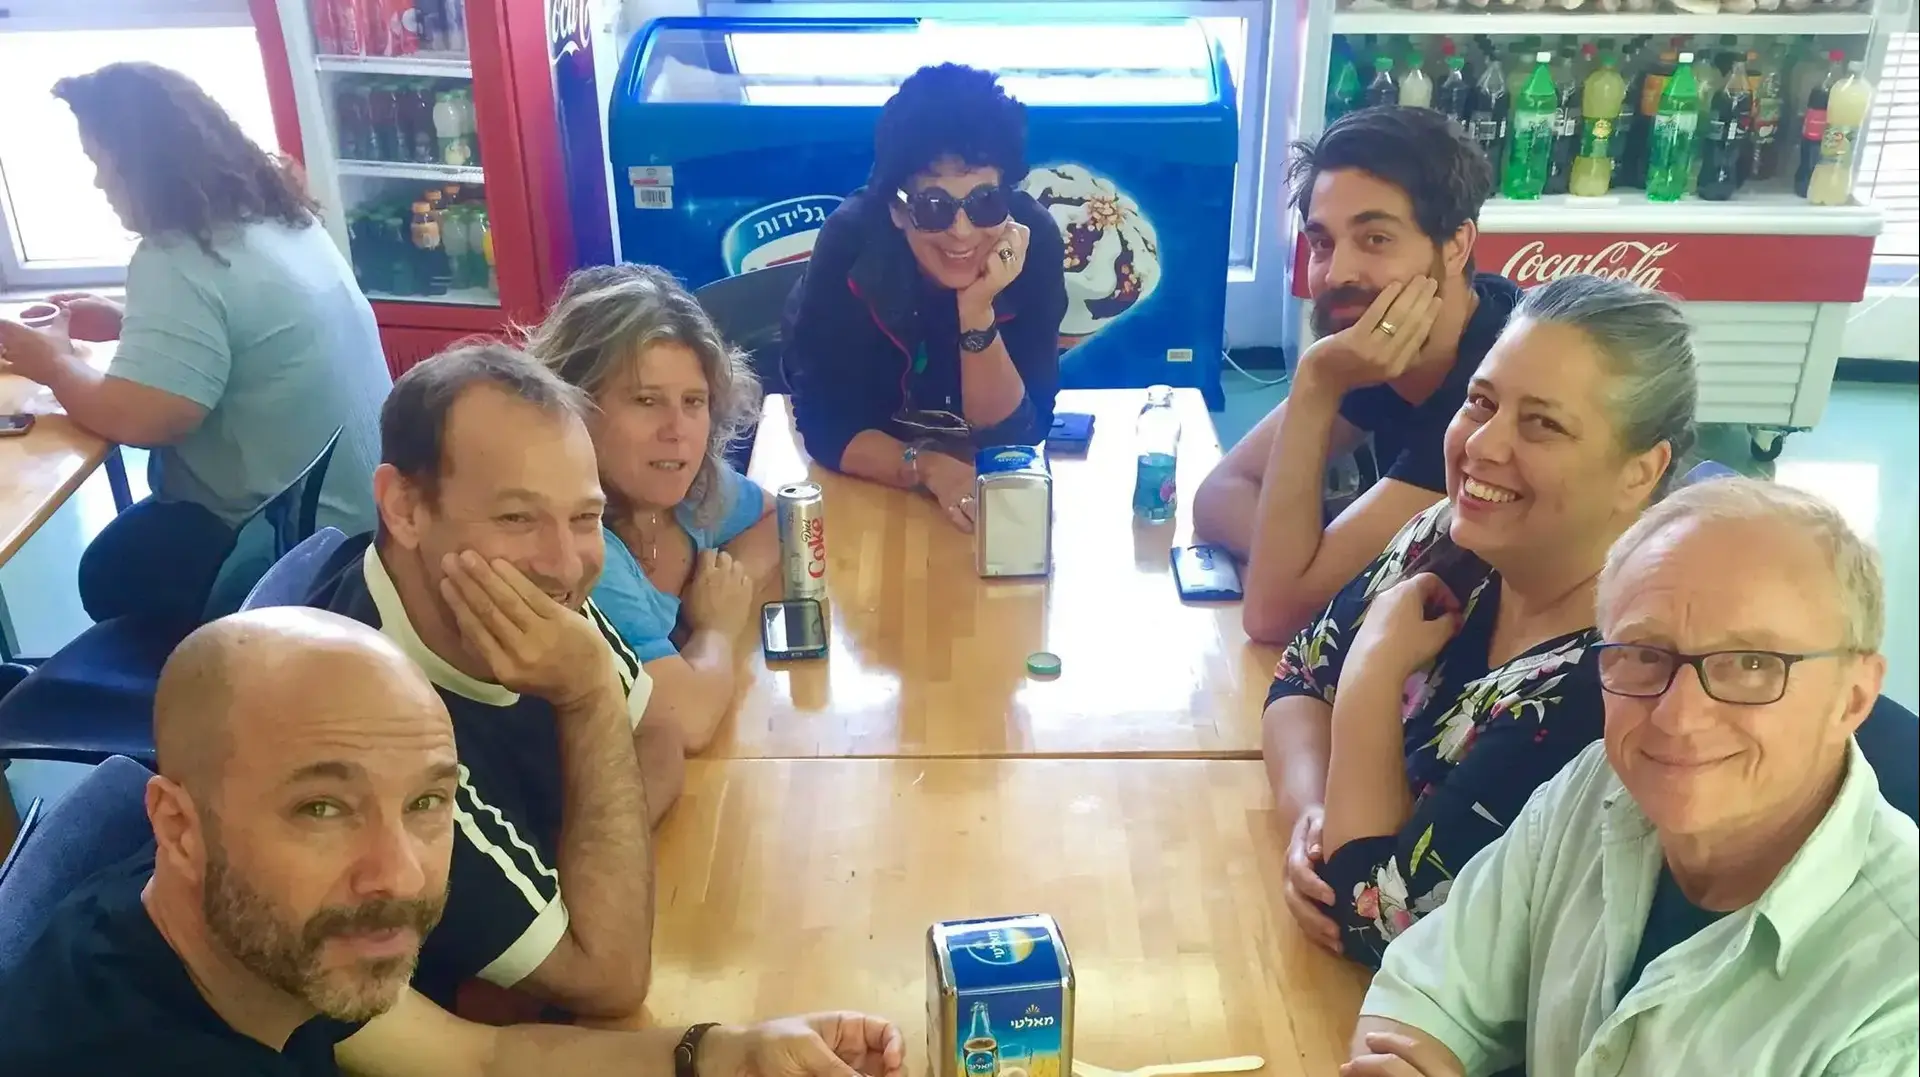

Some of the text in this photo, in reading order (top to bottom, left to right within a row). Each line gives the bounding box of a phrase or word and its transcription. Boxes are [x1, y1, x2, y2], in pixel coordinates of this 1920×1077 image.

[754, 204, 826, 239] גלידות
[1500, 240, 1680, 291] Coca-Cola
[801, 517, 825, 578] Diet Coke
[1010, 1015, 1053, 1028] מאלטי
